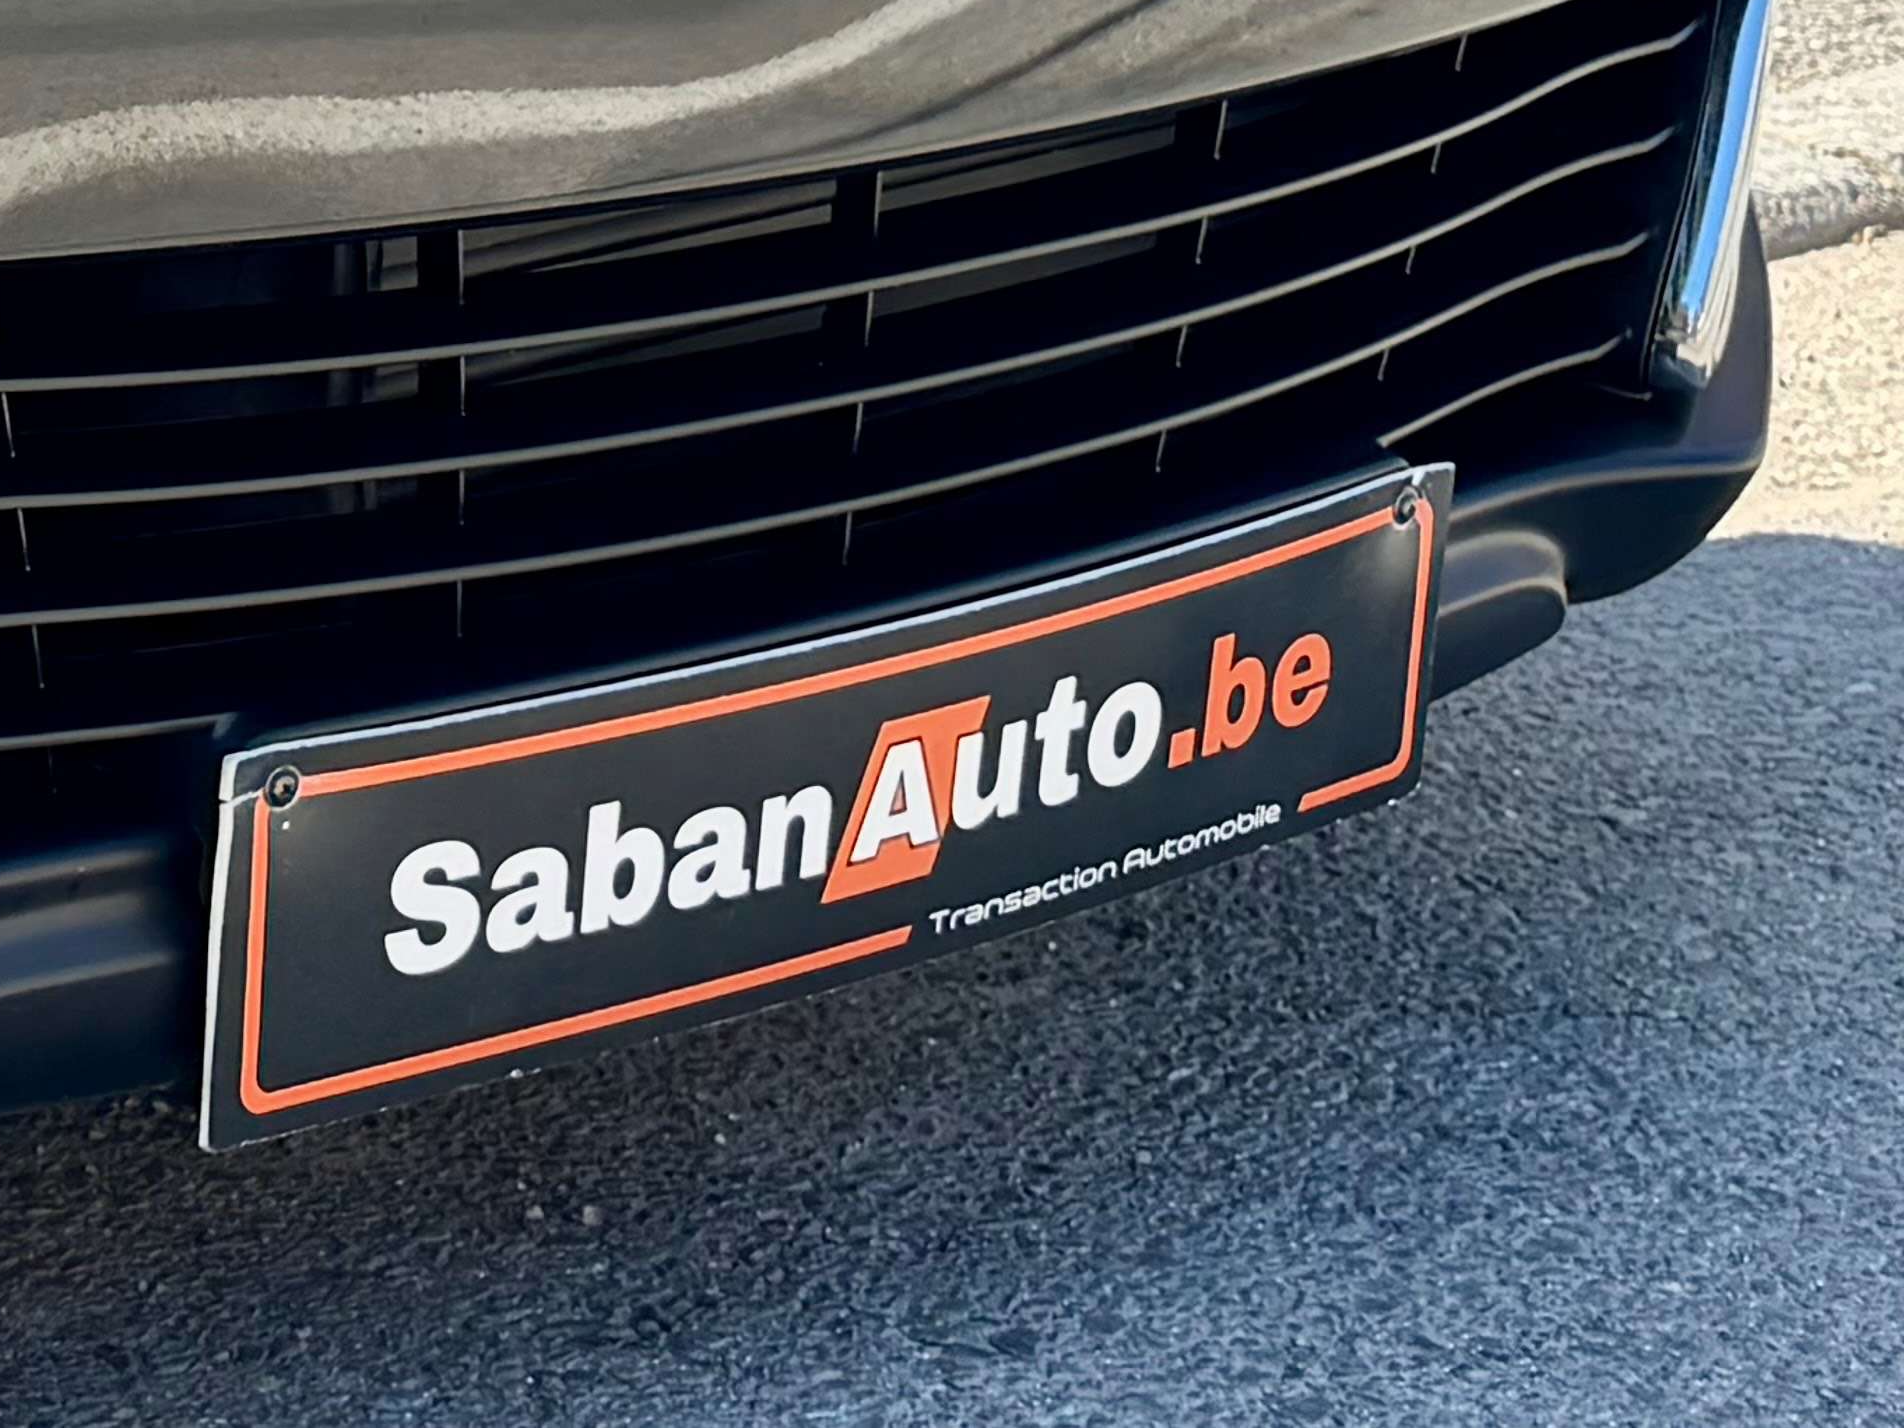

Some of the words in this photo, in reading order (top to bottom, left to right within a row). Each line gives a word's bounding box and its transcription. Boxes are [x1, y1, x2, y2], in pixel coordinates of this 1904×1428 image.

[383, 630, 1334, 978] SabanAuto.be
[927, 861, 1119, 936] Transaction
[1122, 799, 1283, 876] Automobile
